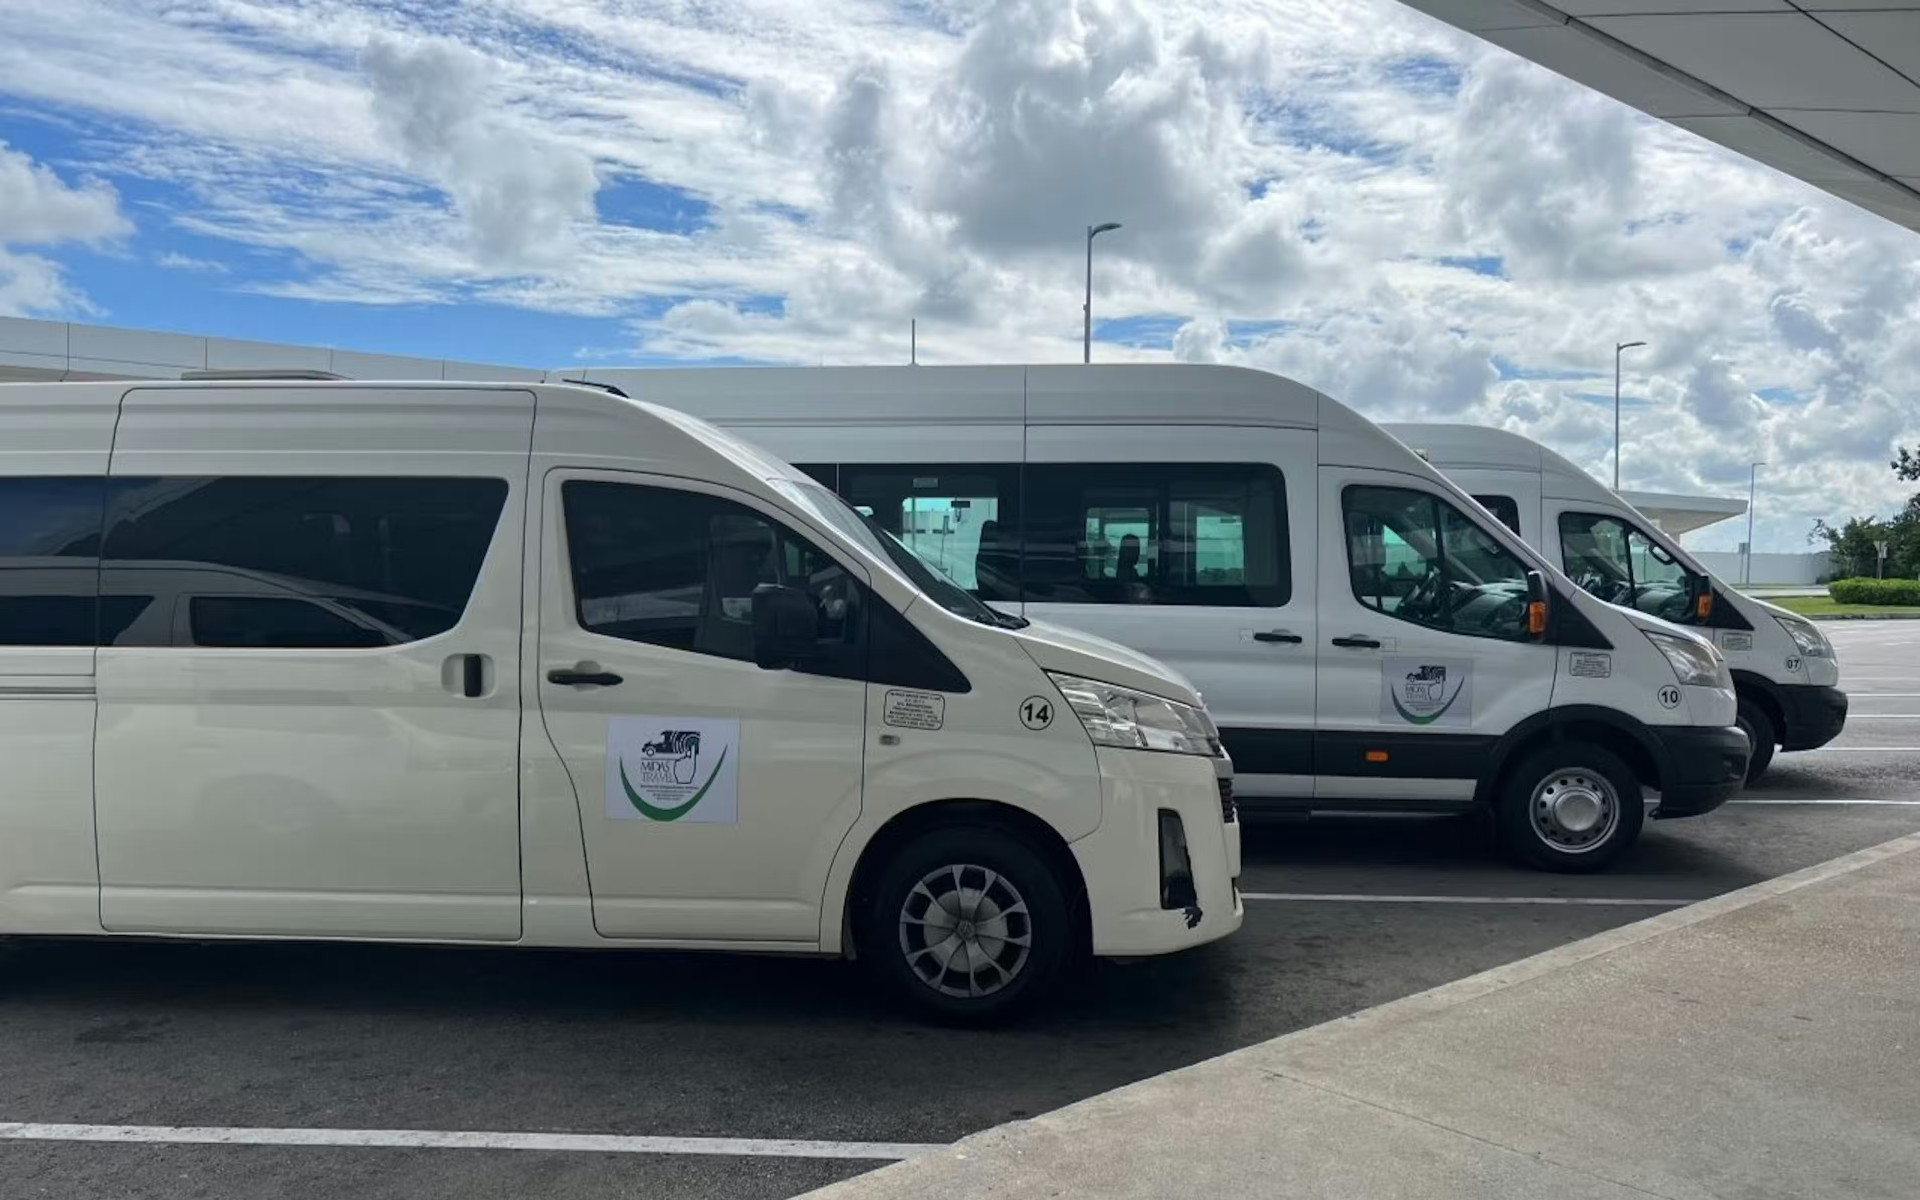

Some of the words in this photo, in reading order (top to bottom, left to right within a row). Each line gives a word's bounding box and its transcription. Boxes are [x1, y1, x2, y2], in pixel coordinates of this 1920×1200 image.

[1787, 659, 1800, 669] 07
[1661, 690, 1679, 703] 10
[1024, 703, 1049, 723] 14
[641, 761, 670, 772] MIDAS
